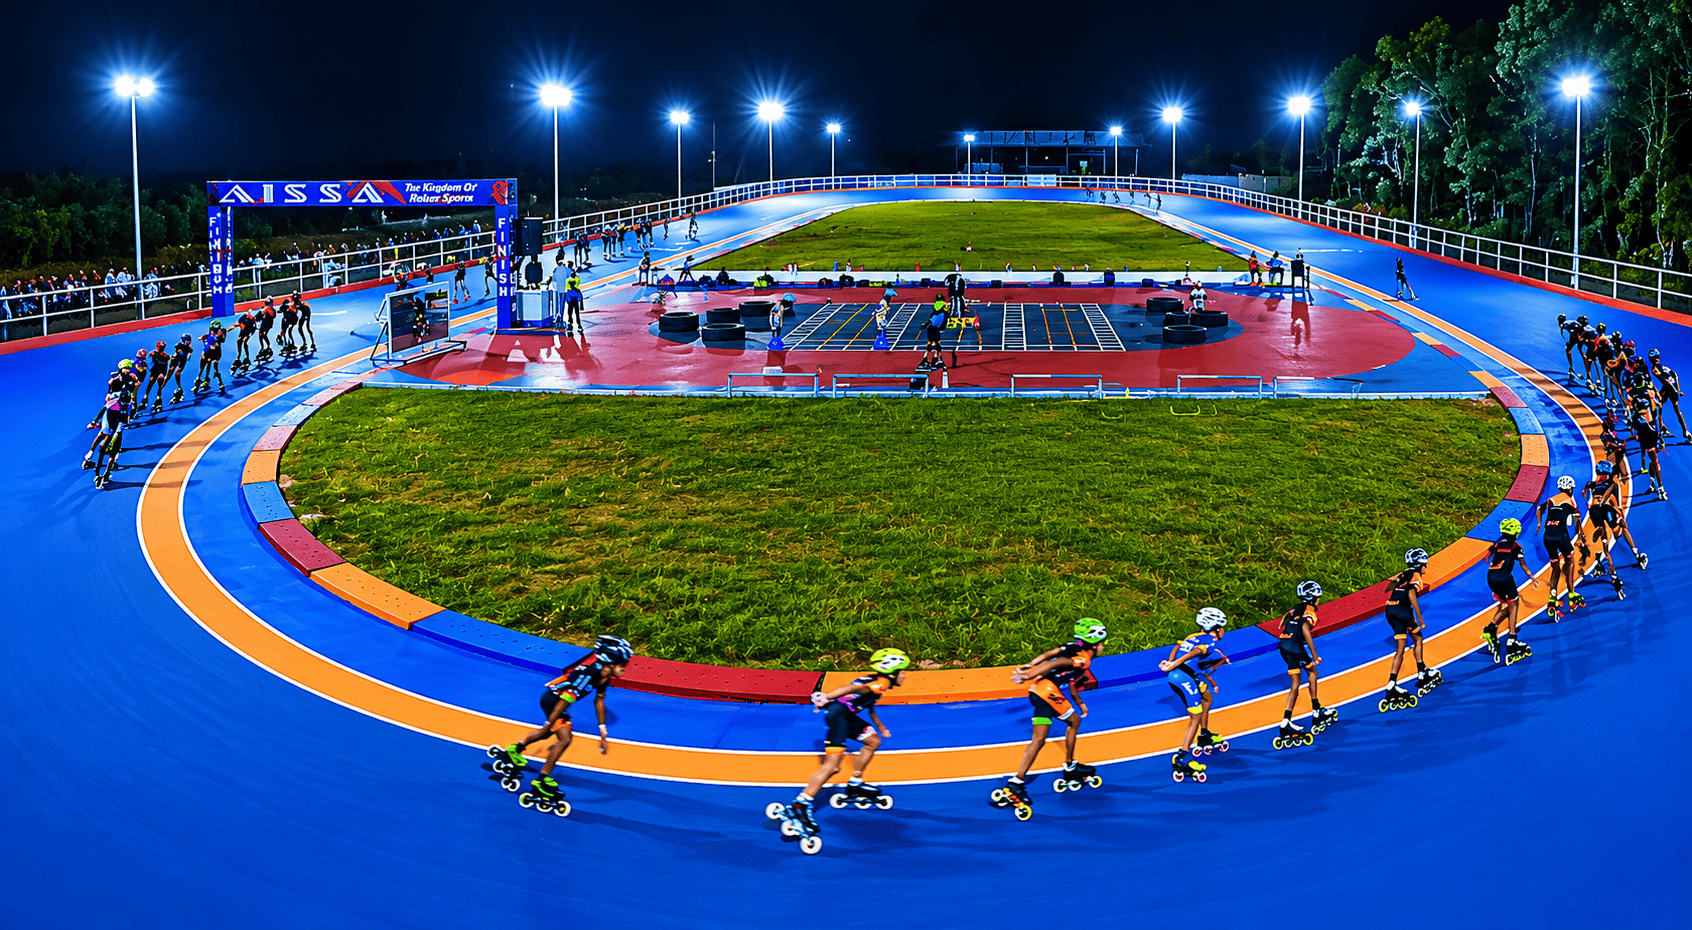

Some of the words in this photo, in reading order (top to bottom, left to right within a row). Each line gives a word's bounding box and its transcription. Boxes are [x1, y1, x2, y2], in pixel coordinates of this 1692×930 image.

[218, 182, 385, 203] AISSA
[405, 183, 421, 192] The
[497, 217, 508, 297] FINISH
